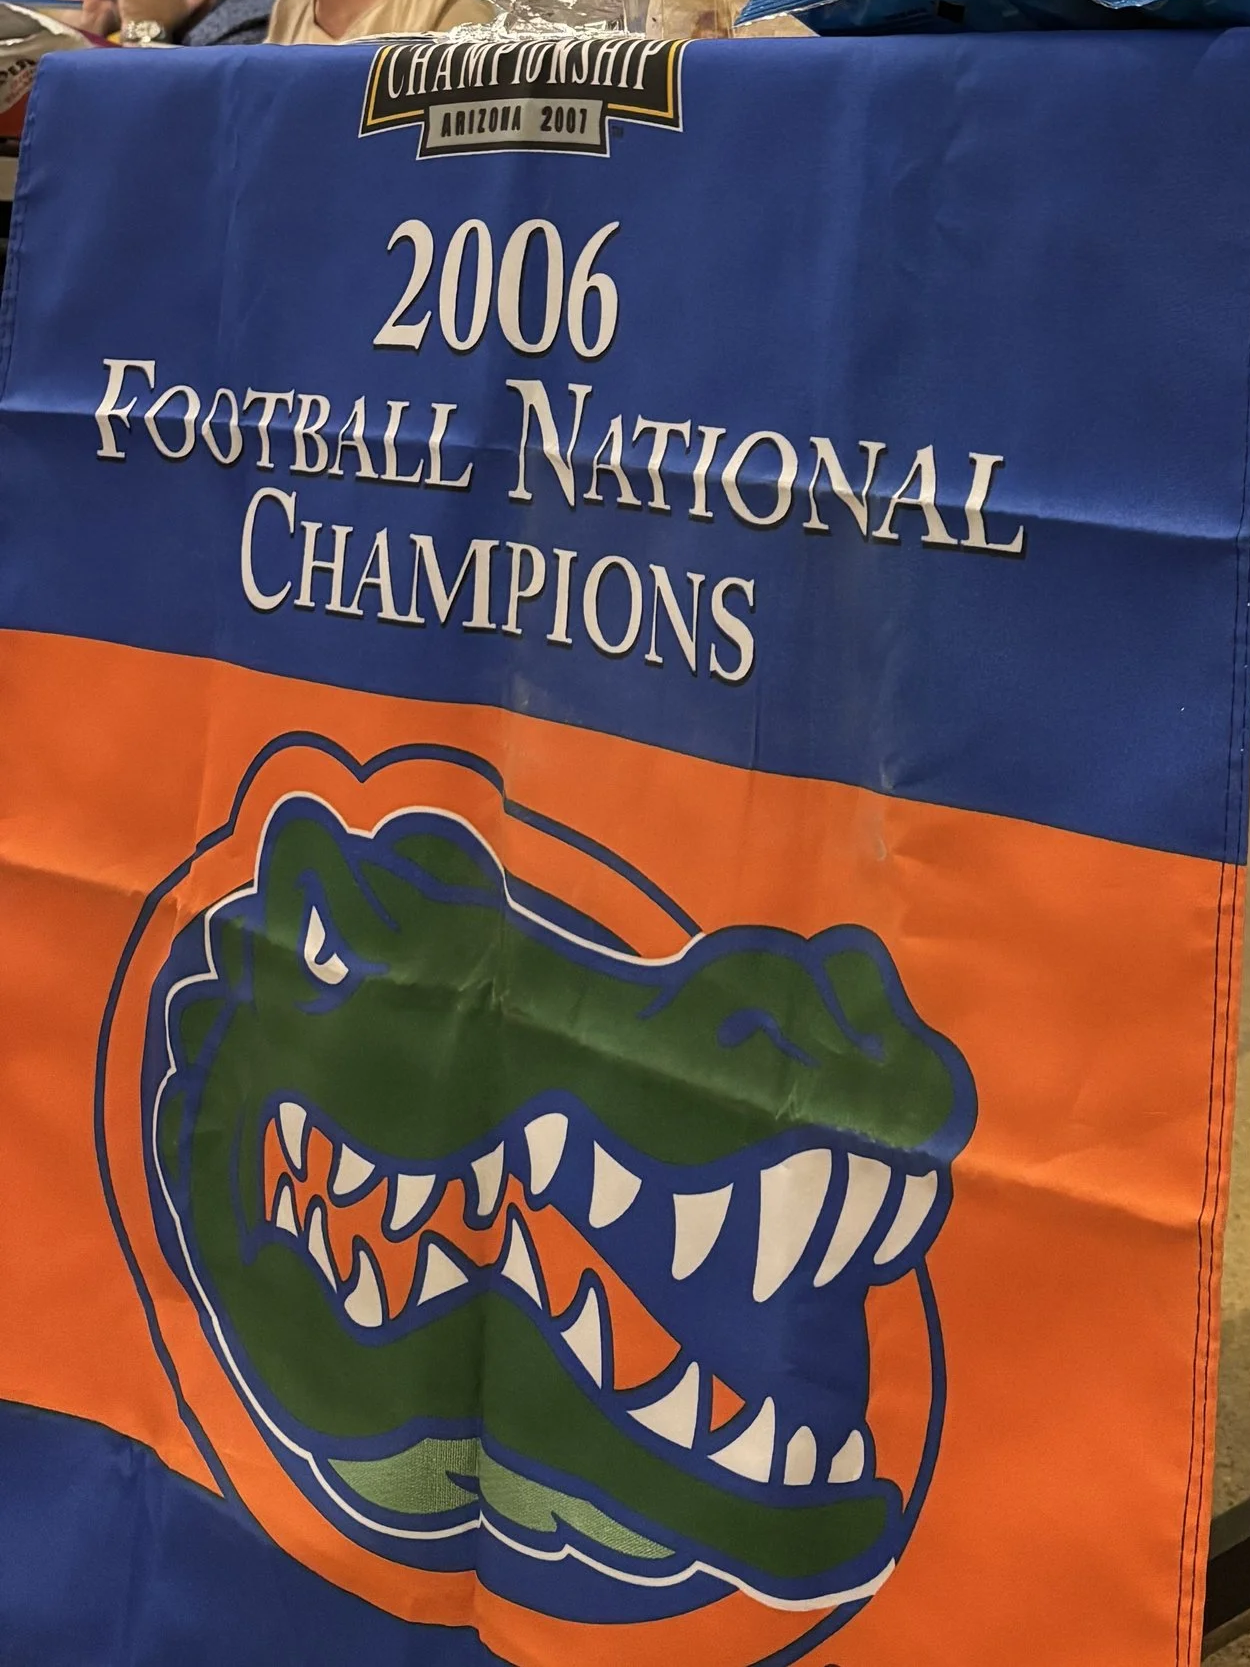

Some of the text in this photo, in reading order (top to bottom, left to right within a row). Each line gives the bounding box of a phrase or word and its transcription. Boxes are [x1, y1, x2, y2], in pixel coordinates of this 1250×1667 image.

[387, 38, 673, 100] CHAMPIONSHIP
[440, 105, 588, 138] ARIZONA 2007
[372, 217, 621, 360] 2006
[95, 357, 1028, 557] FOOTBALL NATIONAL
[240, 486, 757, 685] CHAMPIONS
